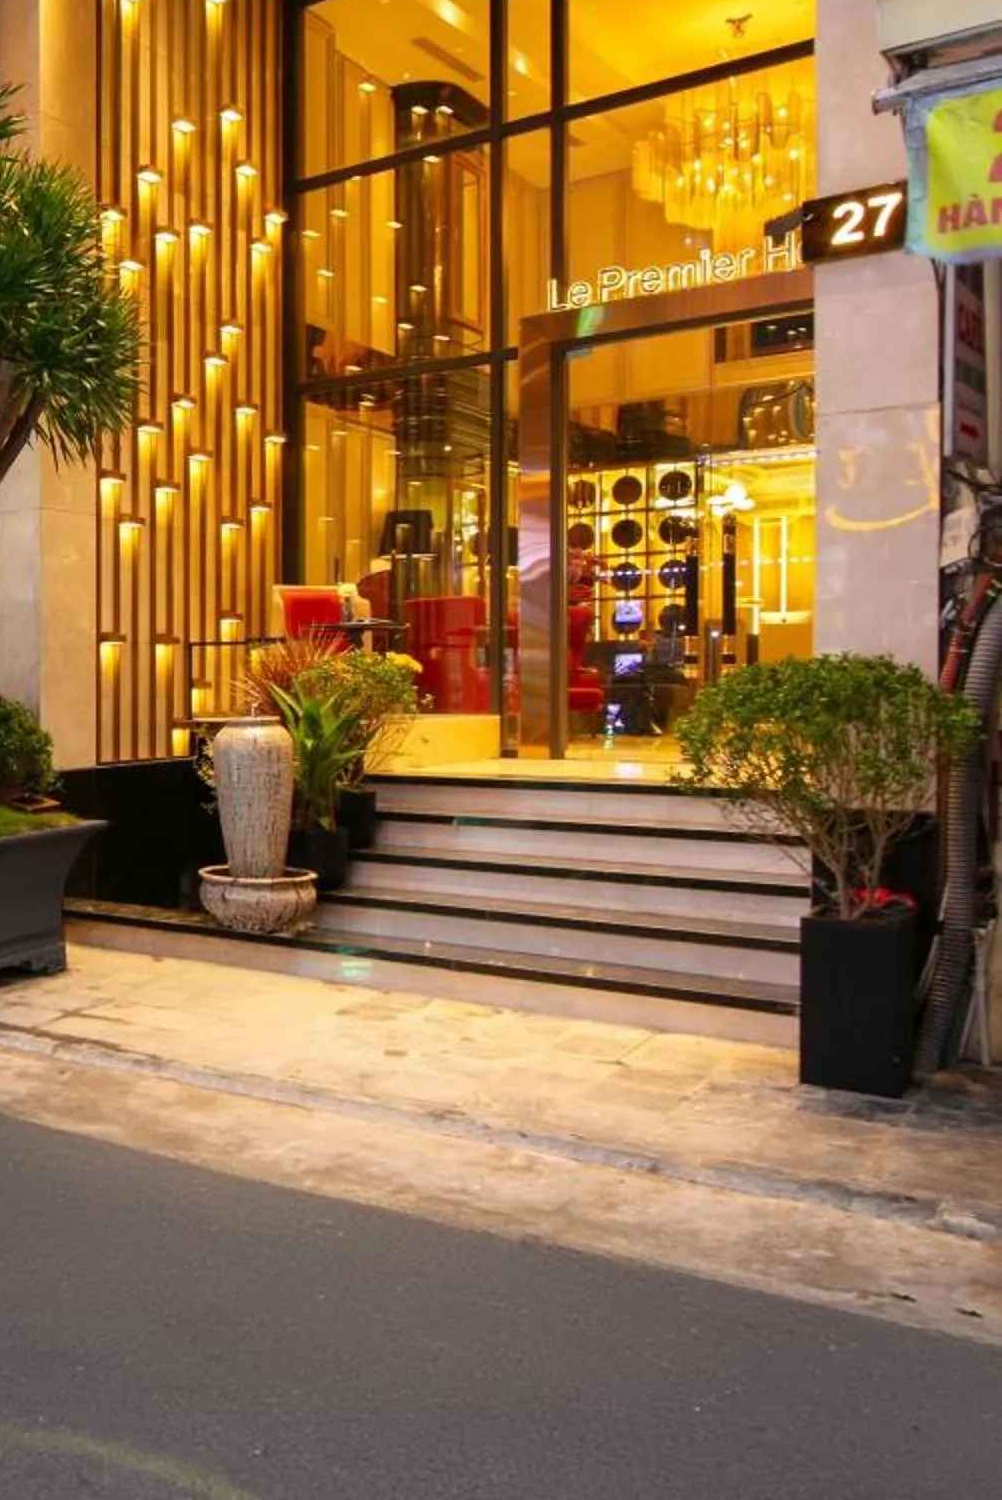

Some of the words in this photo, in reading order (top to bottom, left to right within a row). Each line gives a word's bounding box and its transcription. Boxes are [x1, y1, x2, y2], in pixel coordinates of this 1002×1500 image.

[831, 192, 903, 246] 27
[548, 277, 593, 312] Le
[600, 248, 756, 302] Premier
